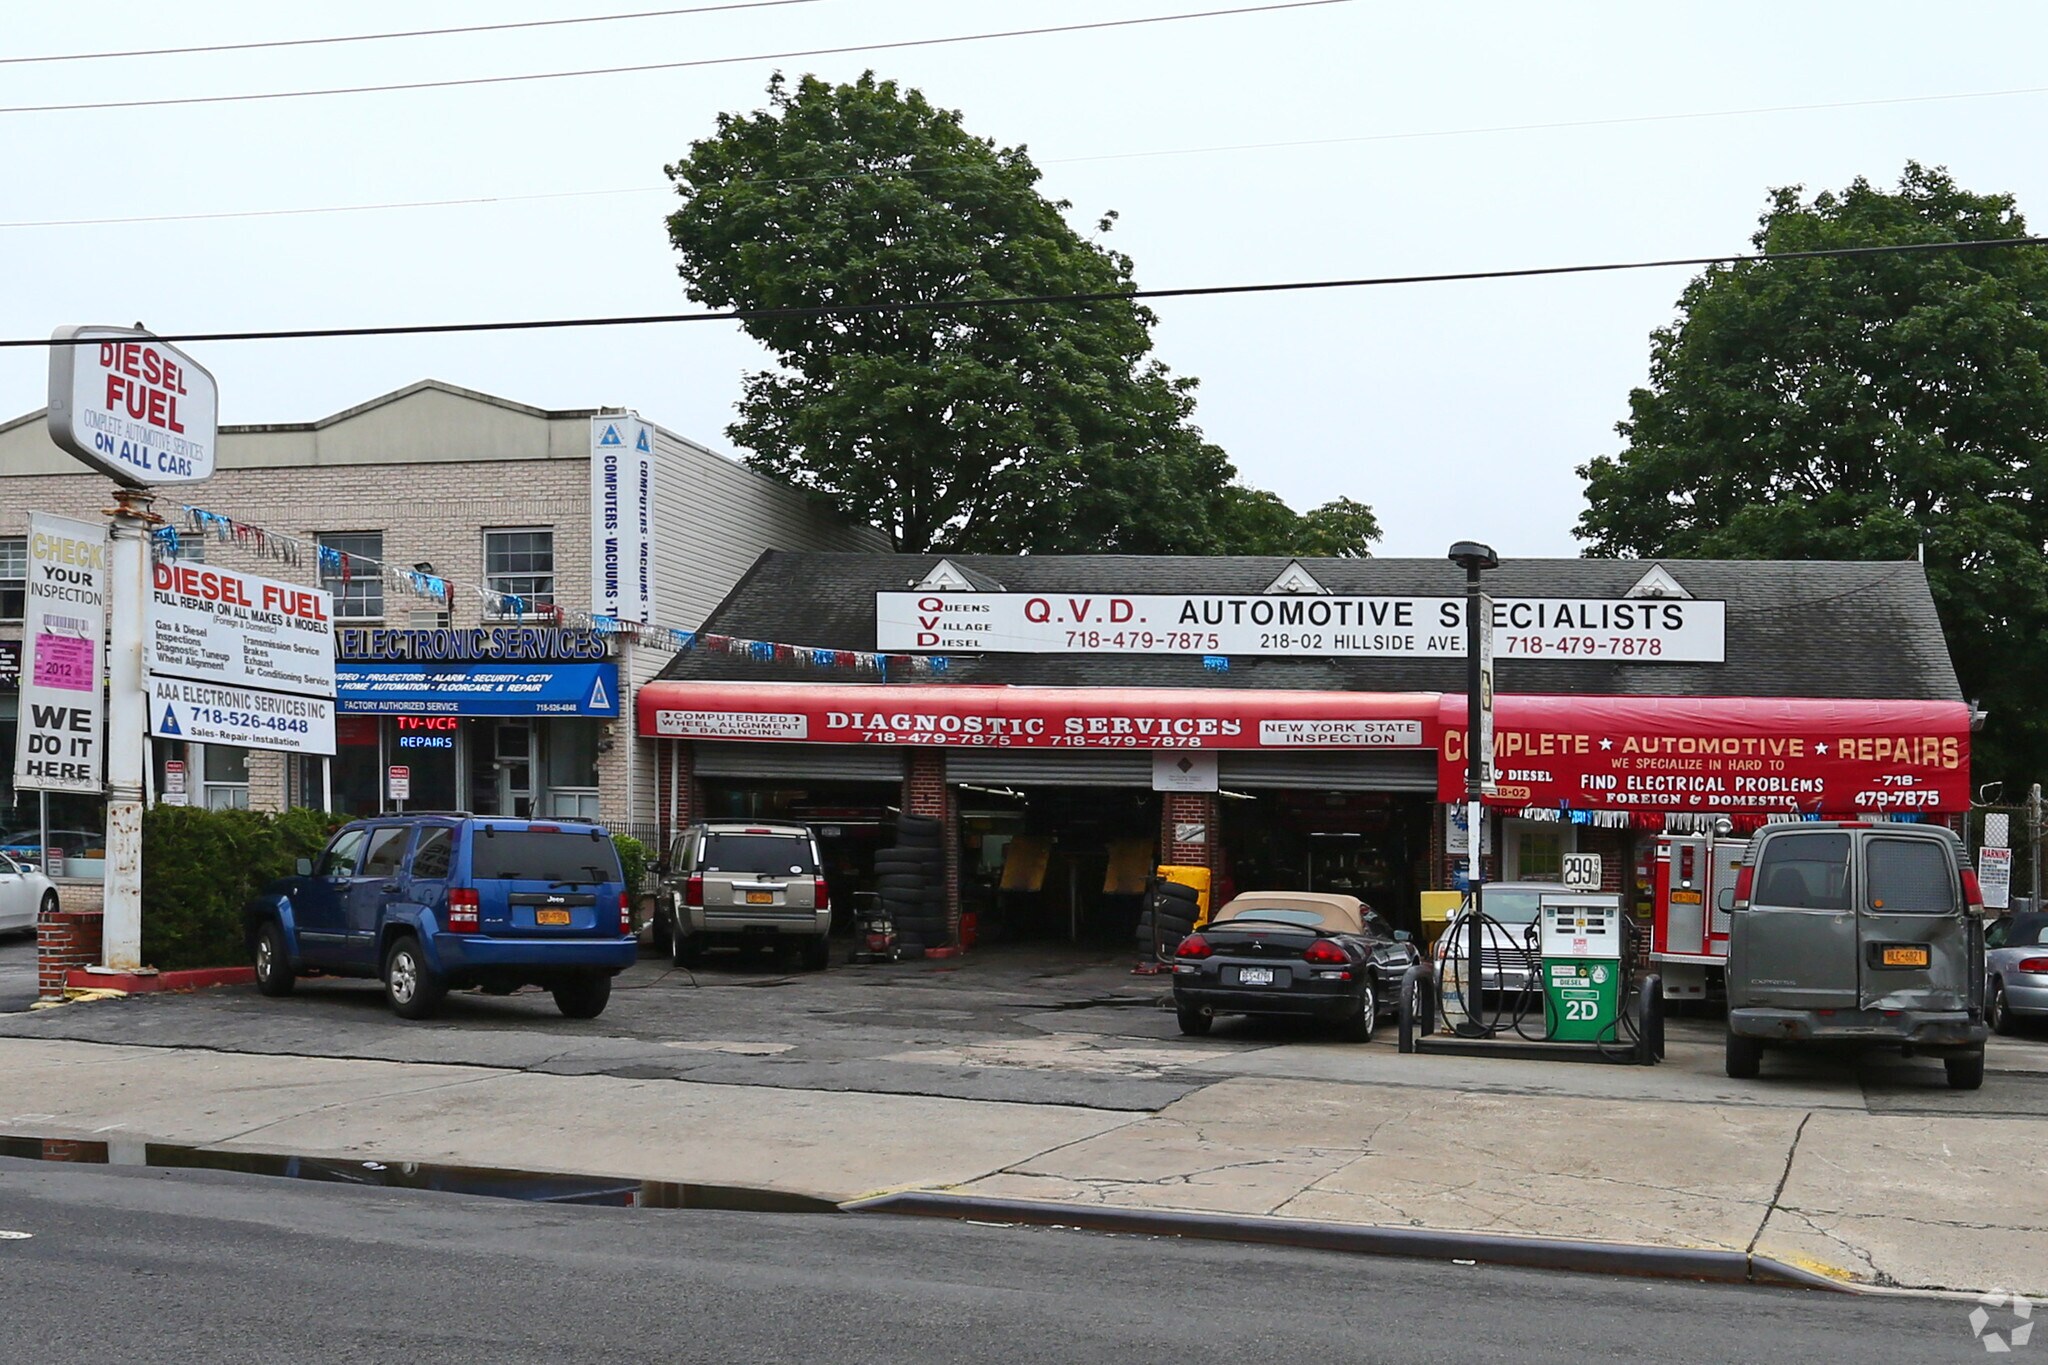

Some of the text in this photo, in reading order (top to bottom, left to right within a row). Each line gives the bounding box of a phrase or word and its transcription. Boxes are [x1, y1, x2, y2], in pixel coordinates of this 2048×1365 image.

[100, 341, 187, 396] DIESEL
[106, 375, 185, 435] FUEL
[84, 408, 204, 461] COMPLETE AUTOMOTIVE SERVICES
[95, 432, 192, 477] ON ALL CARS
[604, 455, 618, 530] COMPUTERS
[639, 460, 649, 534] COMPUTERS
[32, 532, 104, 570] CHECK
[43, 565, 93, 587] YOUR
[604, 537, 618, 598] VACUUMS
[639, 542, 649, 602] VACUUMS
[31, 581, 102, 606] INSPECTION
[153, 562, 328, 622] DIESEL FUEL
[154, 591, 328, 635] FULL REPAIR ON ALL MAKES & MODELS
[1024, 598, 1684, 630] Q.V.D. AUTOMOTIVE SECIALISTS
[156, 620, 207, 637] Gas & Diesel
[156, 631, 202, 647] Inspections
[243, 635, 291, 651] Transmission
[293, 643, 320, 656] Service
[343, 628, 488, 660] ELECTRONIC
[490, 628, 605, 660] SERVICES
[916, 633, 982, 648] DIESEL
[1065, 631, 1662, 656] 718-479-7875 218-02 HILLSIDE AVE. 718-479-7878
[156, 642, 230, 662] Diagnostic Tuneup
[243, 645, 269, 658] Brakes
[46, 662, 72, 676] 2012
[156, 652, 225, 672] Wheel Alignment
[244, 655, 273, 669] Exhaust
[244, 667, 330, 687] Air Conditioning Service
[341, 682, 543, 692] HOME AUTOMATION FLOORCARE & REPAIR
[365, 674, 425, 683] PROJECTORS
[432, 674, 467, 683] ALARM
[472, 674, 518, 683] SECURITY
[525, 674, 553, 683] CCTV
[156, 682, 326, 719] AAA ELECTRONIC SERVICES INC
[344, 700, 377, 711] FACTORY
[378, 701, 425, 712] AUTHORIZED
[426, 702, 459, 712] SERVICE
[31, 703, 92, 733] WE
[190, 706, 309, 734] 718-526-4848
[662, 719, 800, 730] WHEEL ALIGNMENT
[673, 712, 788, 723] COMPUTERIZED
[825, 712, 1243, 736] DIAGNOSTIC SERVICES
[700, 727, 782, 736] BALANCING
[1264, 723, 1417, 734] NEW YORK STATE
[28, 733, 93, 758] DO IT
[253, 734, 300, 747] Installation
[400, 736, 453, 748] REPAIRS
[862, 731, 1202, 748] 718-479-7875 718-479-7878
[1286, 734, 1395, 744] INSPECTION
[1444, 730, 1590, 762] CMPLETE
[1622, 736, 1804, 759] AUTOMOTIVE
[1838, 737, 1960, 769] REPAIRS
[26, 760, 91, 779] HERE
[1611, 758, 1785, 771] WE SPECIALIZE IN HARD TO
[1508, 769, 1553, 782] DIESEL
[1580, 775, 1824, 793] FIND ELECTRICAL PROBLEMS
[1606, 793, 1796, 807] FOREIGN & DOMESTIC
[1855, 790, 1940, 807] 479-7875
[1981, 848, 2009, 859] WARNING
[1565, 857, 1592, 884] 299
[1566, 1001, 1598, 1020] 2D
